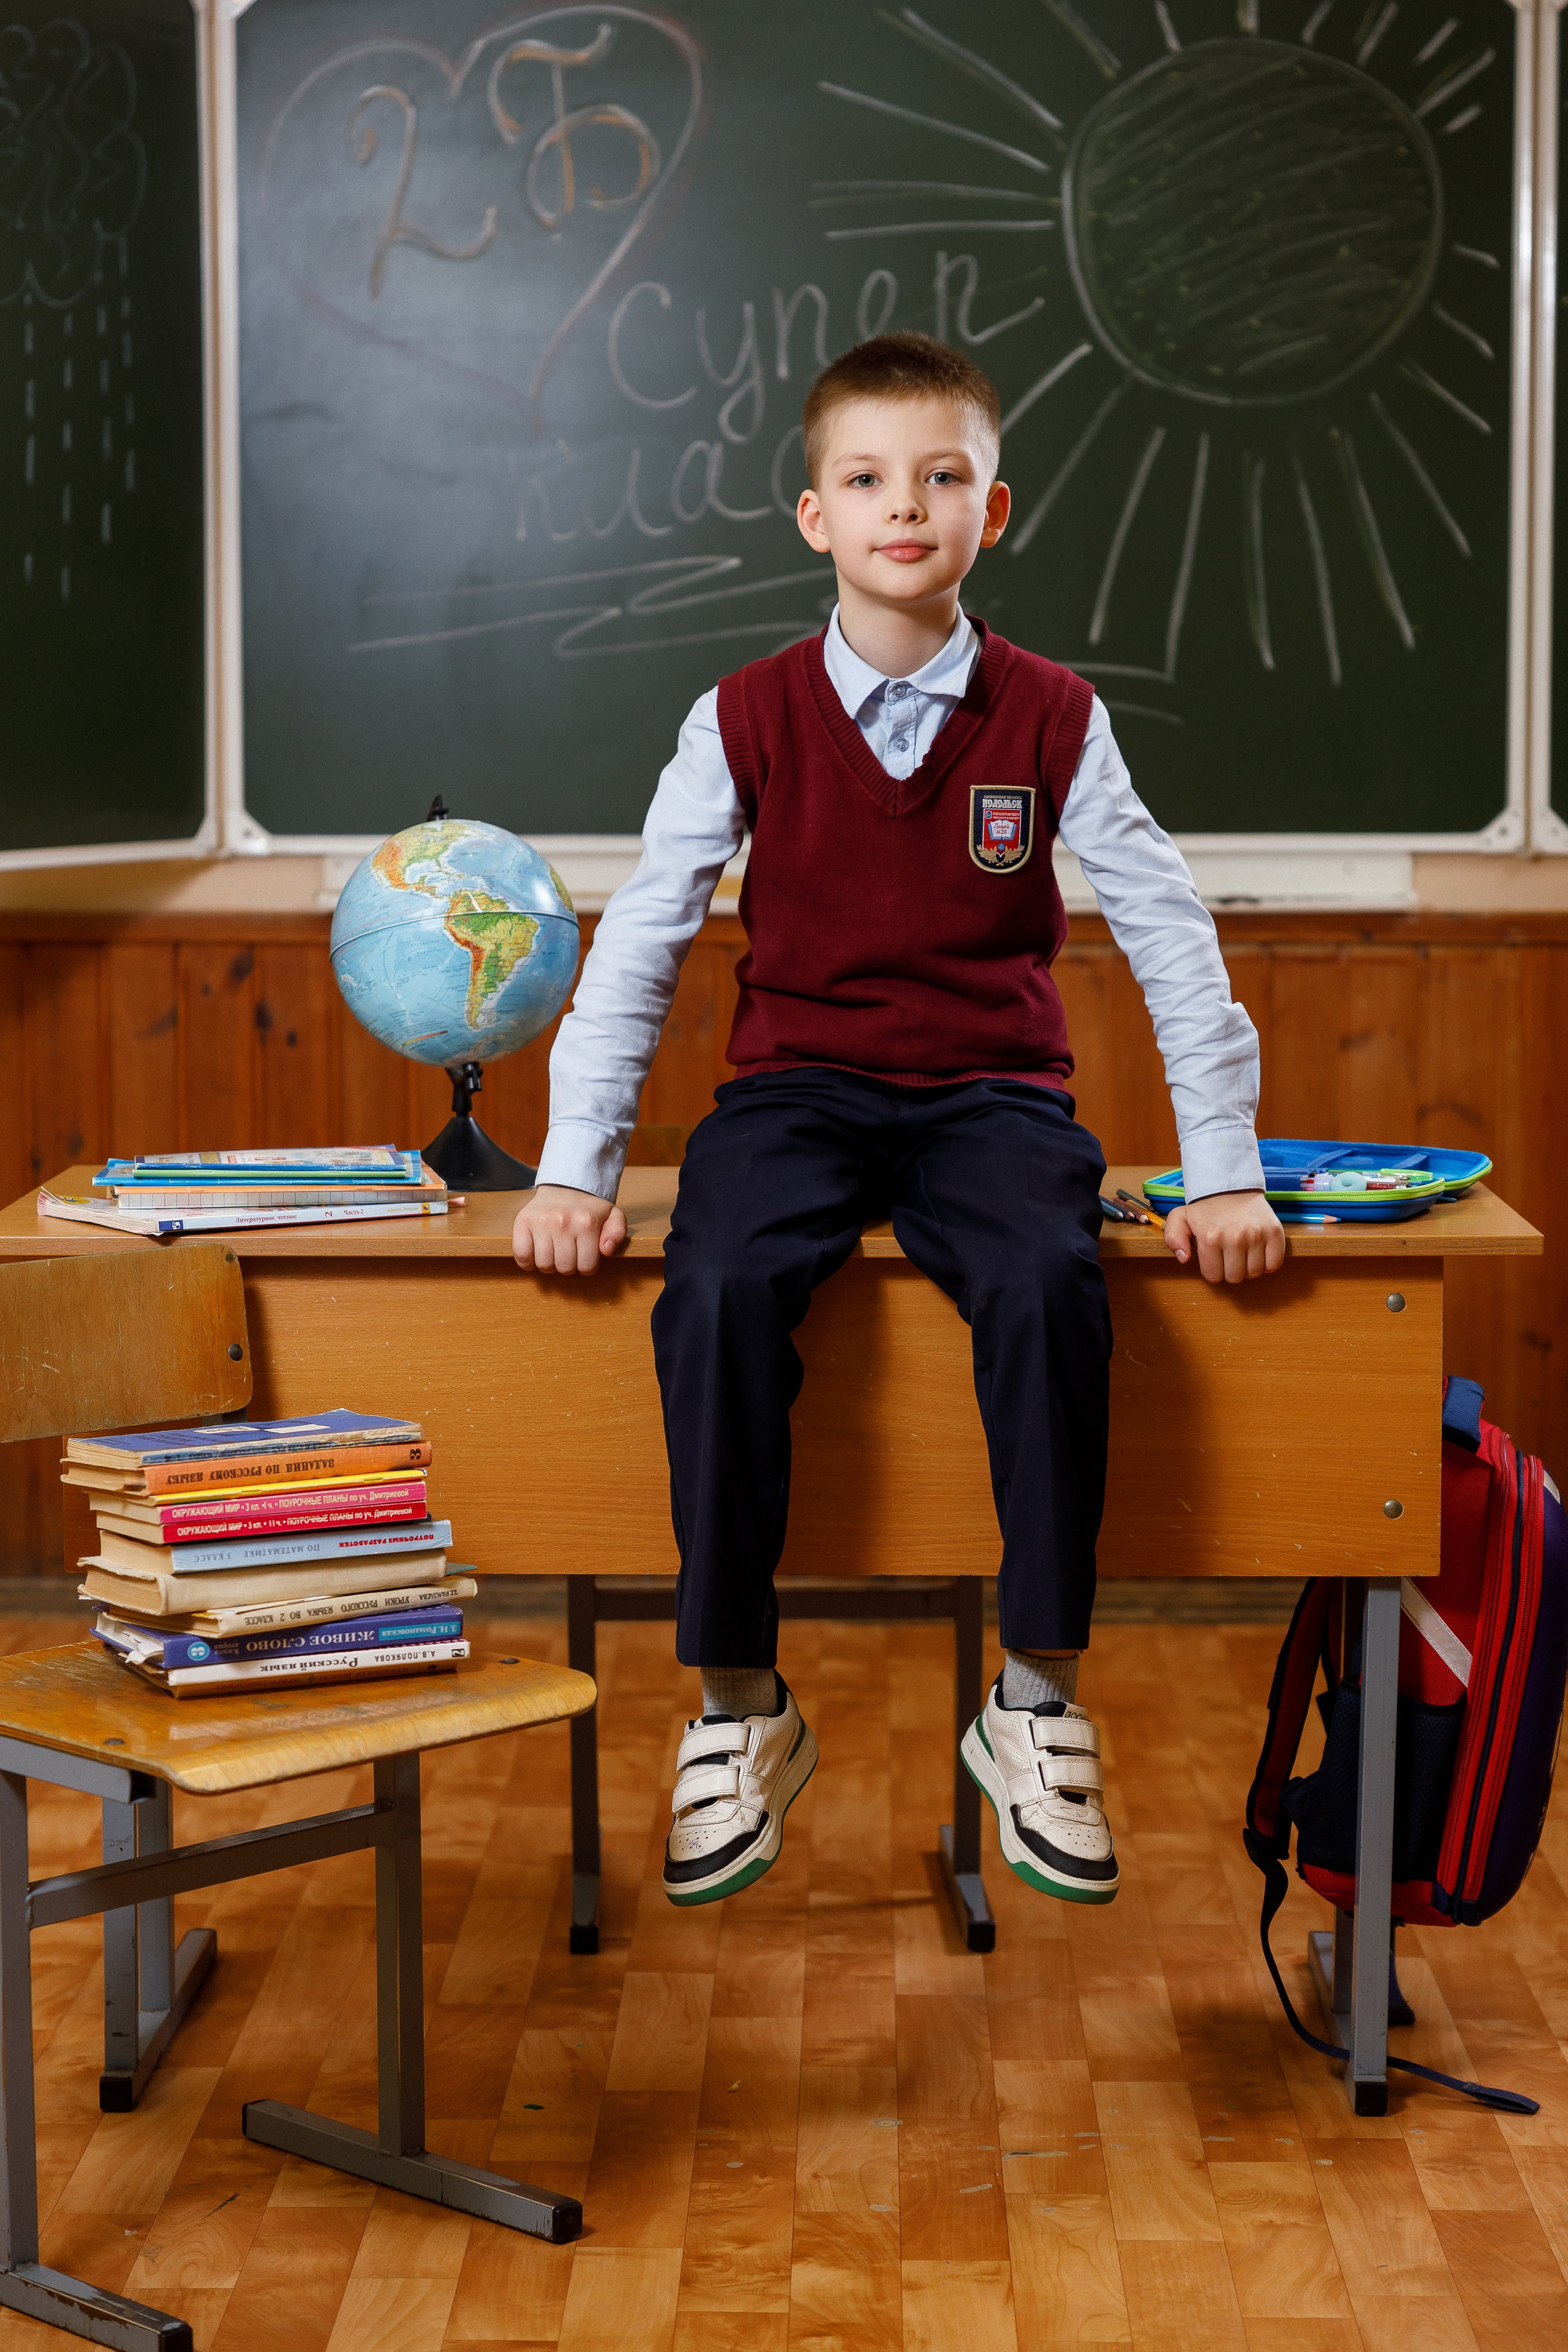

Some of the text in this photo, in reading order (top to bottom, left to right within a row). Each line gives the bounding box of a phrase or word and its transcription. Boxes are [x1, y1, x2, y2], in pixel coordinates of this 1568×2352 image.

[982, 799, 1022, 809] ПОДОЛЬСК
[235, 1215, 276, 1224] Литературное
[409, 1448, 421, 1460] 3
[166, 1458, 335, 1485] ЗАДАНИЯ ПО РУССКОМУ ЯЗЫКУ
[172, 1503, 224, 1518] ОКРУЖАЮЩИЙ
[225, 1503, 240, 1512] МИР
[245, 1502, 250, 1512] 3
[279, 1495, 322, 1509] ПОУРОЧНЫЕ
[323, 1493, 349, 1504] ПЛАНЫ
[359, 1494, 368, 1503] уч.
[369, 1488, 409, 1500] Дмитриевой
[177, 1522, 228, 1537] ОКРУЖАЮЩИЙ
[228, 1521, 243, 1531] МИР
[248, 1521, 252, 1529] 3
[287, 1513, 328, 1526] ПОУРОЧНЫЕ
[329, 1511, 354, 1522] ПЛАНЫ
[364, 1510, 373, 1520] уч.
[374, 1507, 412, 1518] Дмитриевой
[339, 1534, 434, 1548] ПОУРОЧНЫЕ РАЗРАБОТКИ
[194, 1553, 224, 1562] КЛАСС
[244, 1545, 304, 1558] МАТЕМАТИКЕ
[341, 1600, 379, 1612] РУССКОГО
[385, 1596, 410, 1606] УРОКИ
[290, 1610, 301, 1619] ВО
[307, 1605, 333, 1616] ЯЗЫКА
[244, 1614, 274, 1626] КЛАССЕ
[279, 1613, 285, 1622] 2
[382, 1627, 437, 1637] Романовская
[246, 1630, 375, 1652] ЖИВОЕ СЛОВО
[260, 1656, 359, 1672] Русский язык
